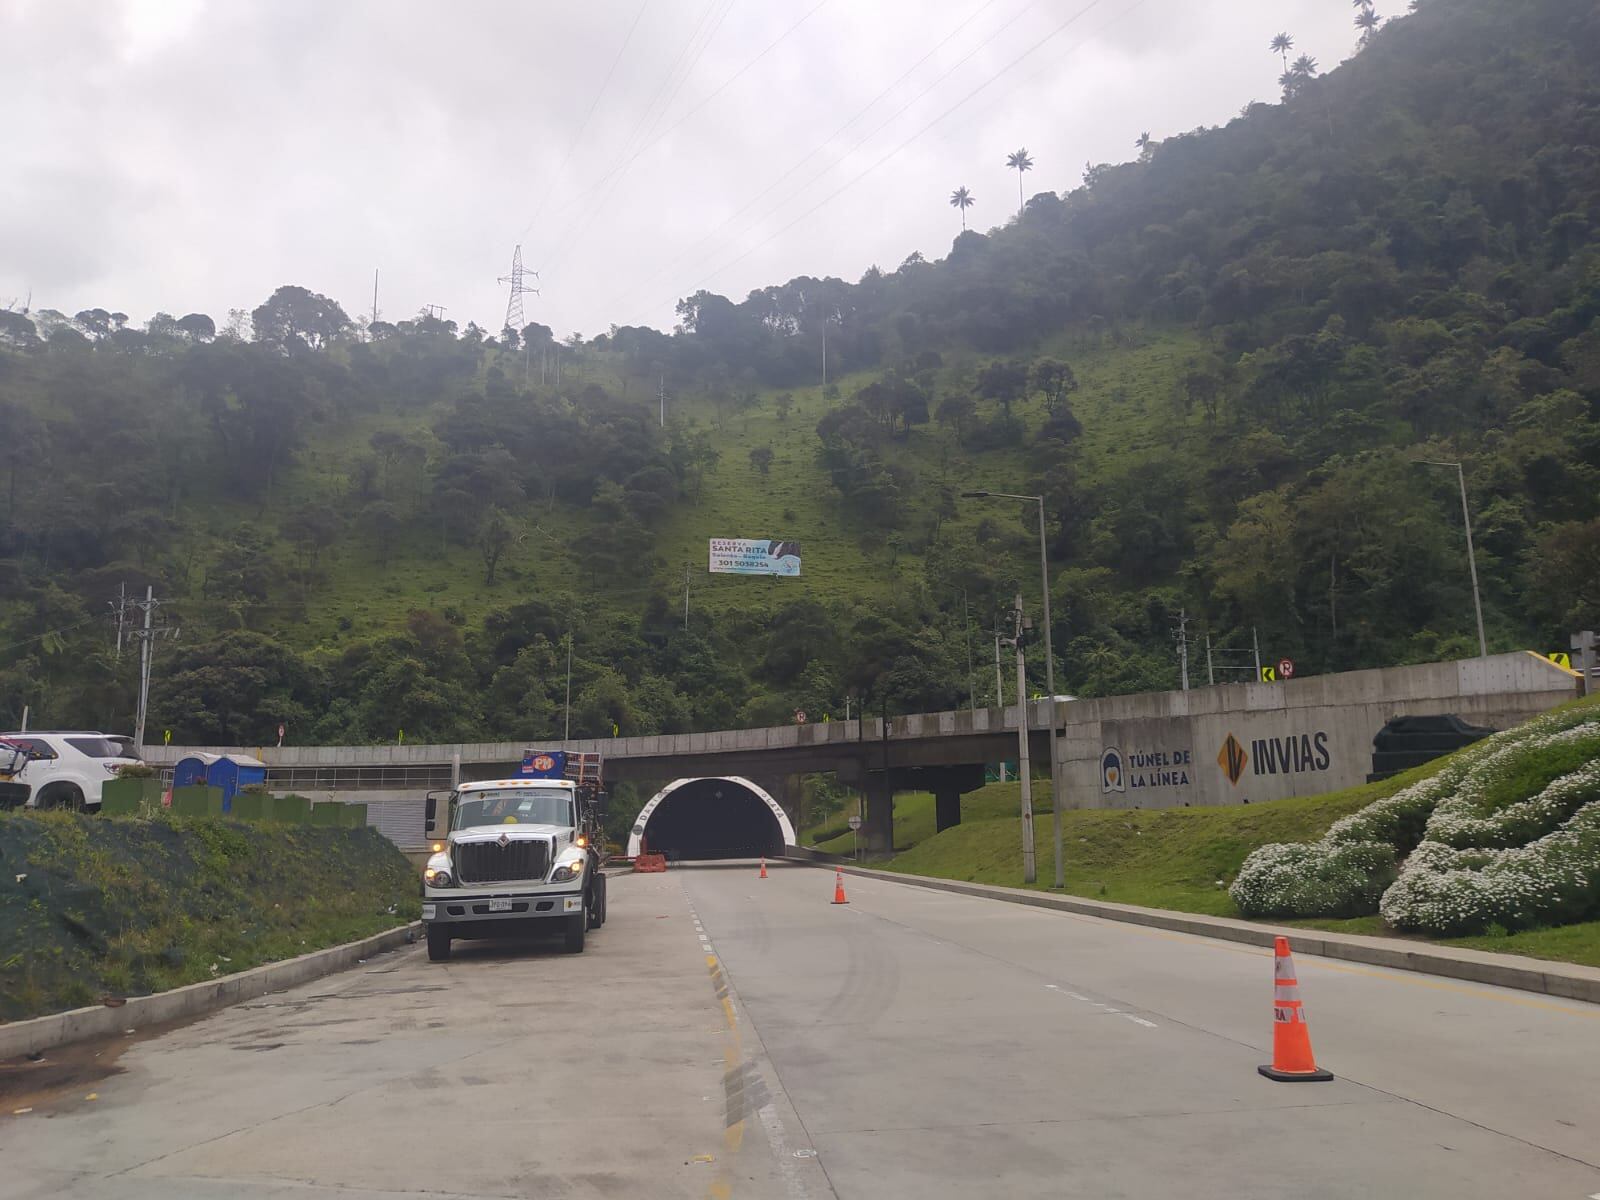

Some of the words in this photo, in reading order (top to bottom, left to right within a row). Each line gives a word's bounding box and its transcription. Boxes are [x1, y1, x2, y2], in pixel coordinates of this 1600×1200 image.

[712, 546, 744, 554] SANTA
[745, 547, 767, 555] RITA
[1129, 750, 1170, 769] TÚNEL
[1173, 750, 1191, 764] DE
[1252, 731, 1330, 775] INVIAS
[1130, 772, 1146, 787] LA
[1150, 768, 1190, 787] LÍNEA
